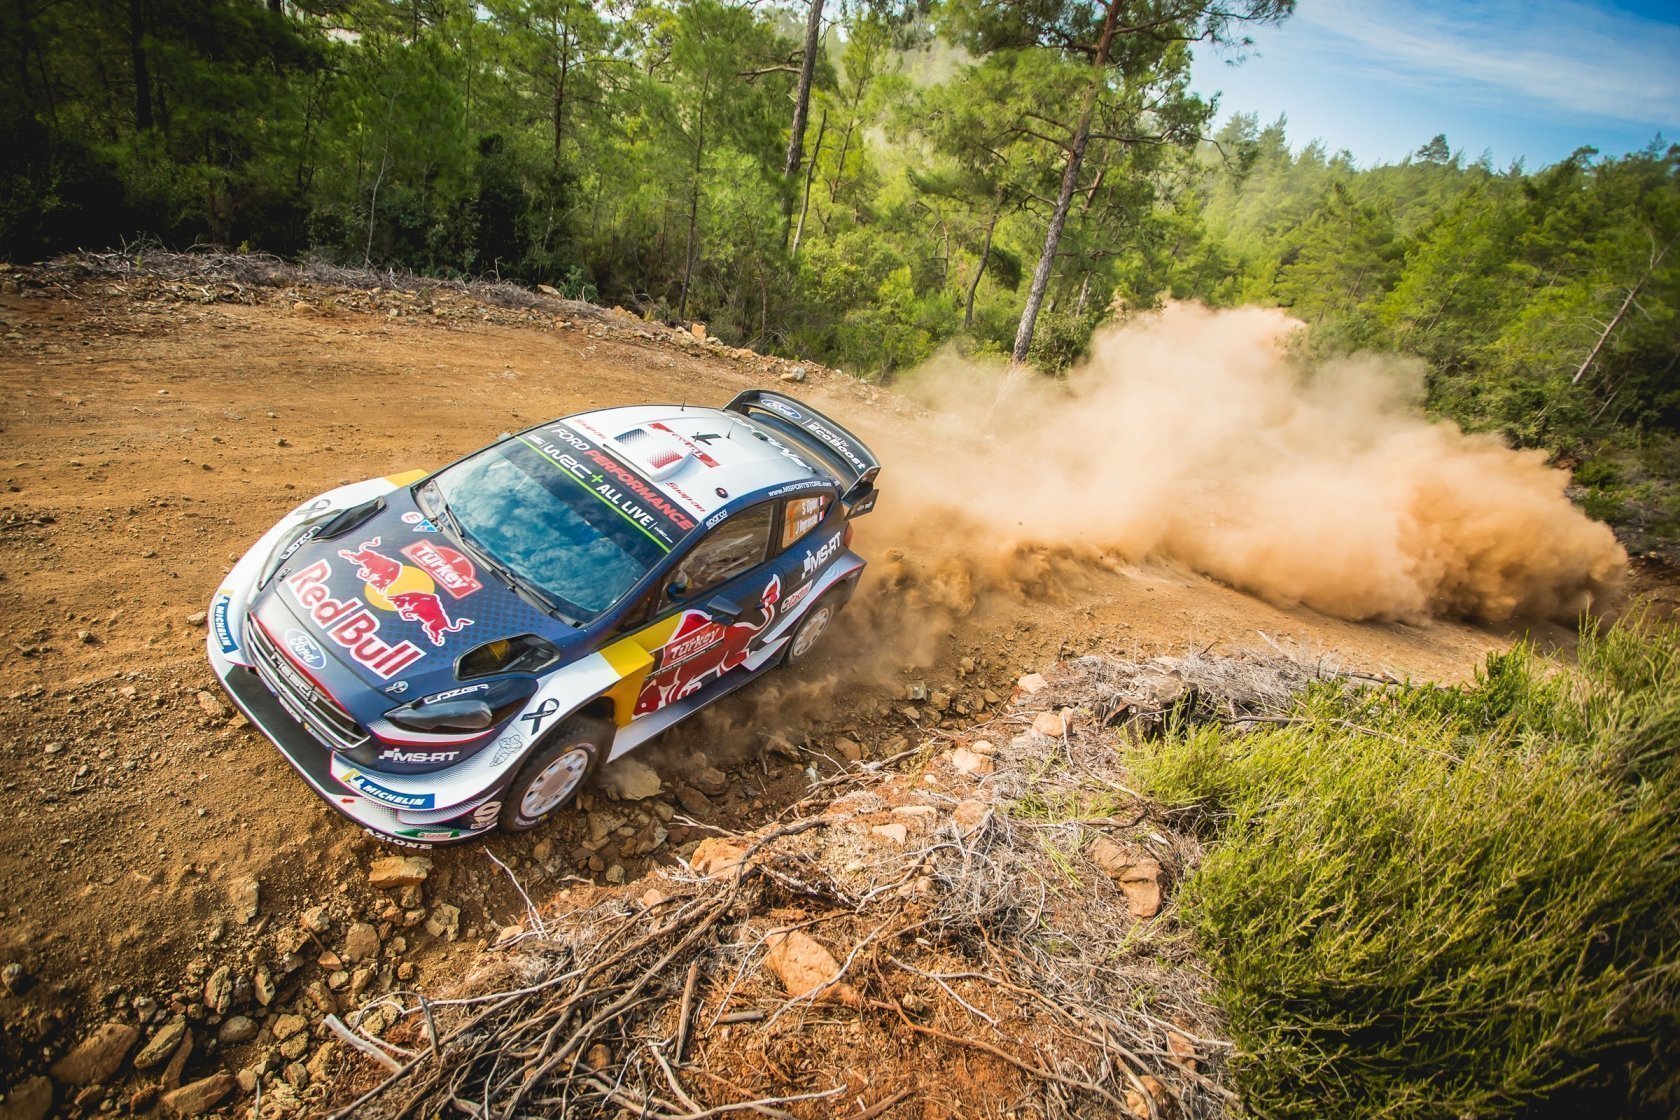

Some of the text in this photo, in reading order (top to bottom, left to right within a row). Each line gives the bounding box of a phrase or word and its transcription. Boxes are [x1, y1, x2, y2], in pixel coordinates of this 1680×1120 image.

[807, 424, 867, 470] EcoBoost
[550, 428, 696, 531] FORD PERFORMANCE
[596, 484, 622, 505] ALL
[621, 501, 654, 526] LIVE
[215, 605, 232, 646] MICHELIN
[287, 559, 361, 627] Red
[329, 610, 423, 678] Bull
[288, 635, 321, 664] Ford
[362, 784, 426, 806] MICHELIN
